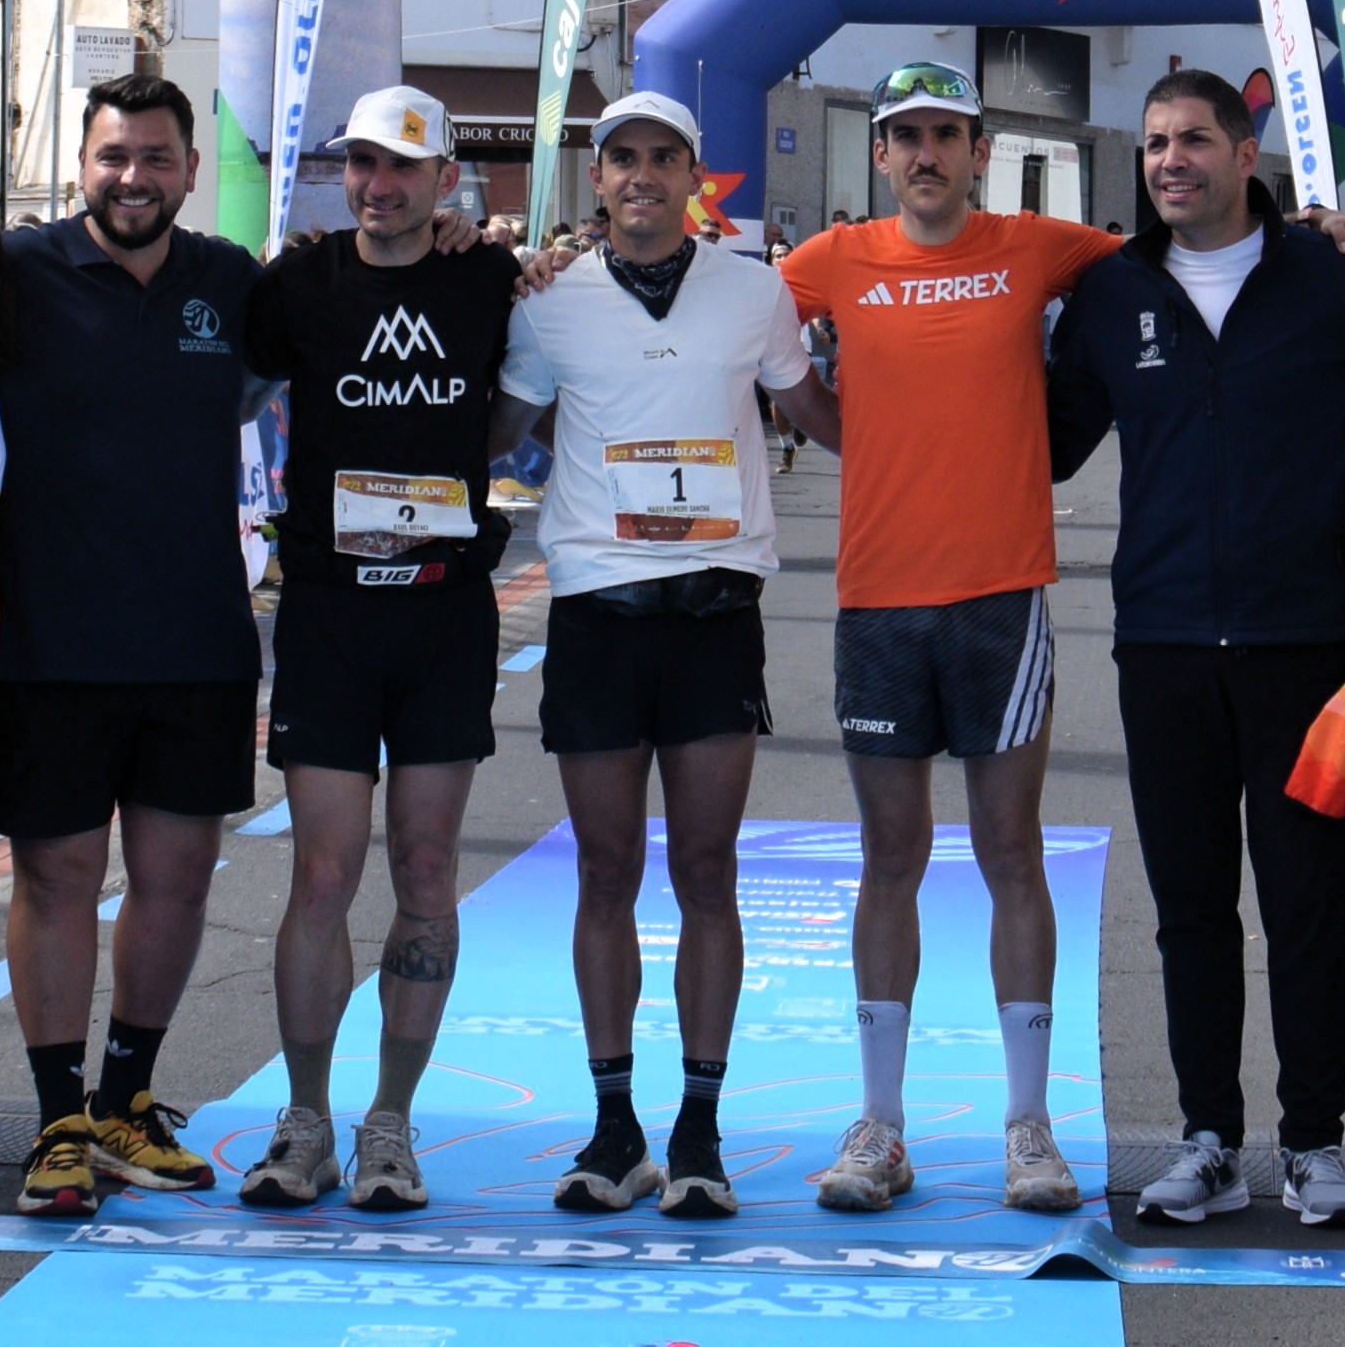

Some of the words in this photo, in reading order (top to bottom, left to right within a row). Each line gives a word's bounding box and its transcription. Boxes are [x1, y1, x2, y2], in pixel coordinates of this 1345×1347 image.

[77, 35, 98, 44] AUTO
[100, 36, 131, 46] LAVADO
[453, 126, 492, 142] ABOR
[900, 270, 1010, 305] TERREX
[336, 373, 466, 407] CIMALP
[670, 467, 687, 502] 1
[362, 569, 413, 582] BIG
[850, 718, 896, 734] TERREX
[152, 1265, 752, 1296] MARATÓN
[779, 1282, 1013, 1303] DEL
